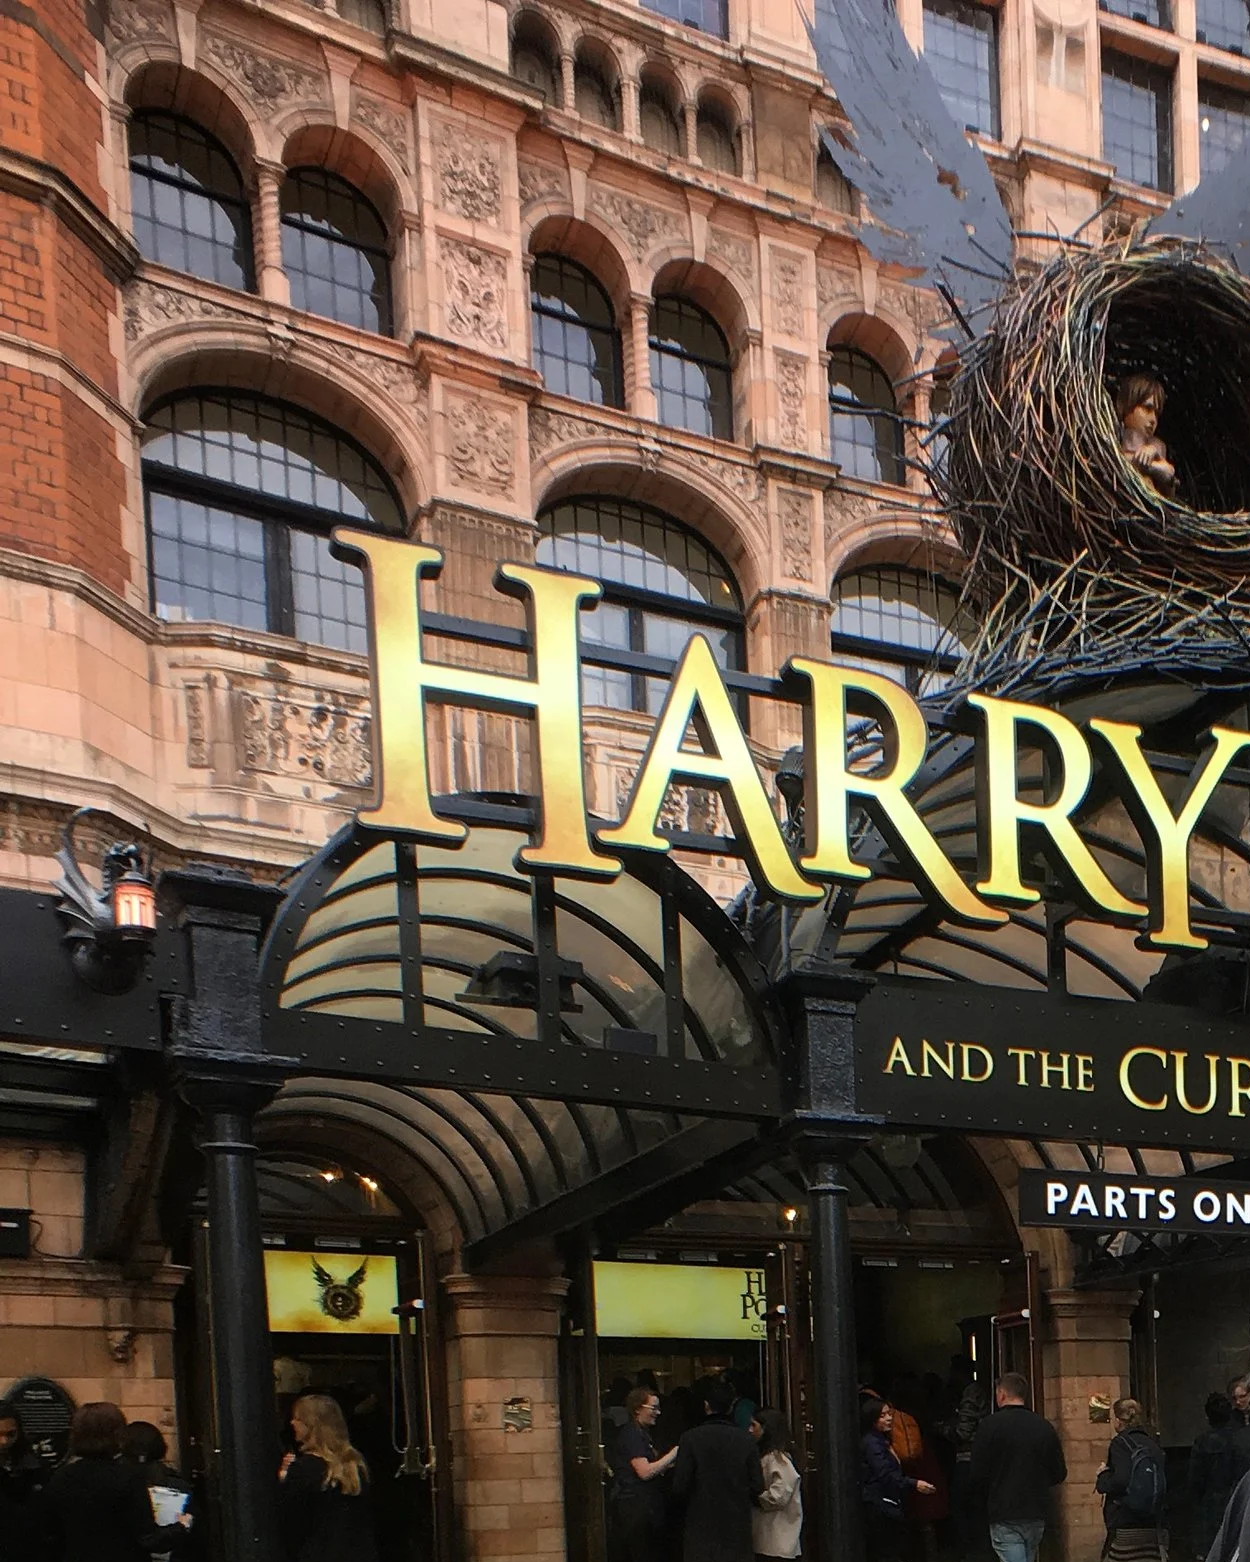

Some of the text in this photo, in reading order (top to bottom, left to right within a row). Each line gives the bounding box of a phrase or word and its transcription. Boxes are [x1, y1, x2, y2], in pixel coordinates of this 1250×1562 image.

[882, 1036, 994, 1083] AND
[1007, 1047, 1095, 1092] THE
[1045, 1182, 1177, 1221] PARTS
